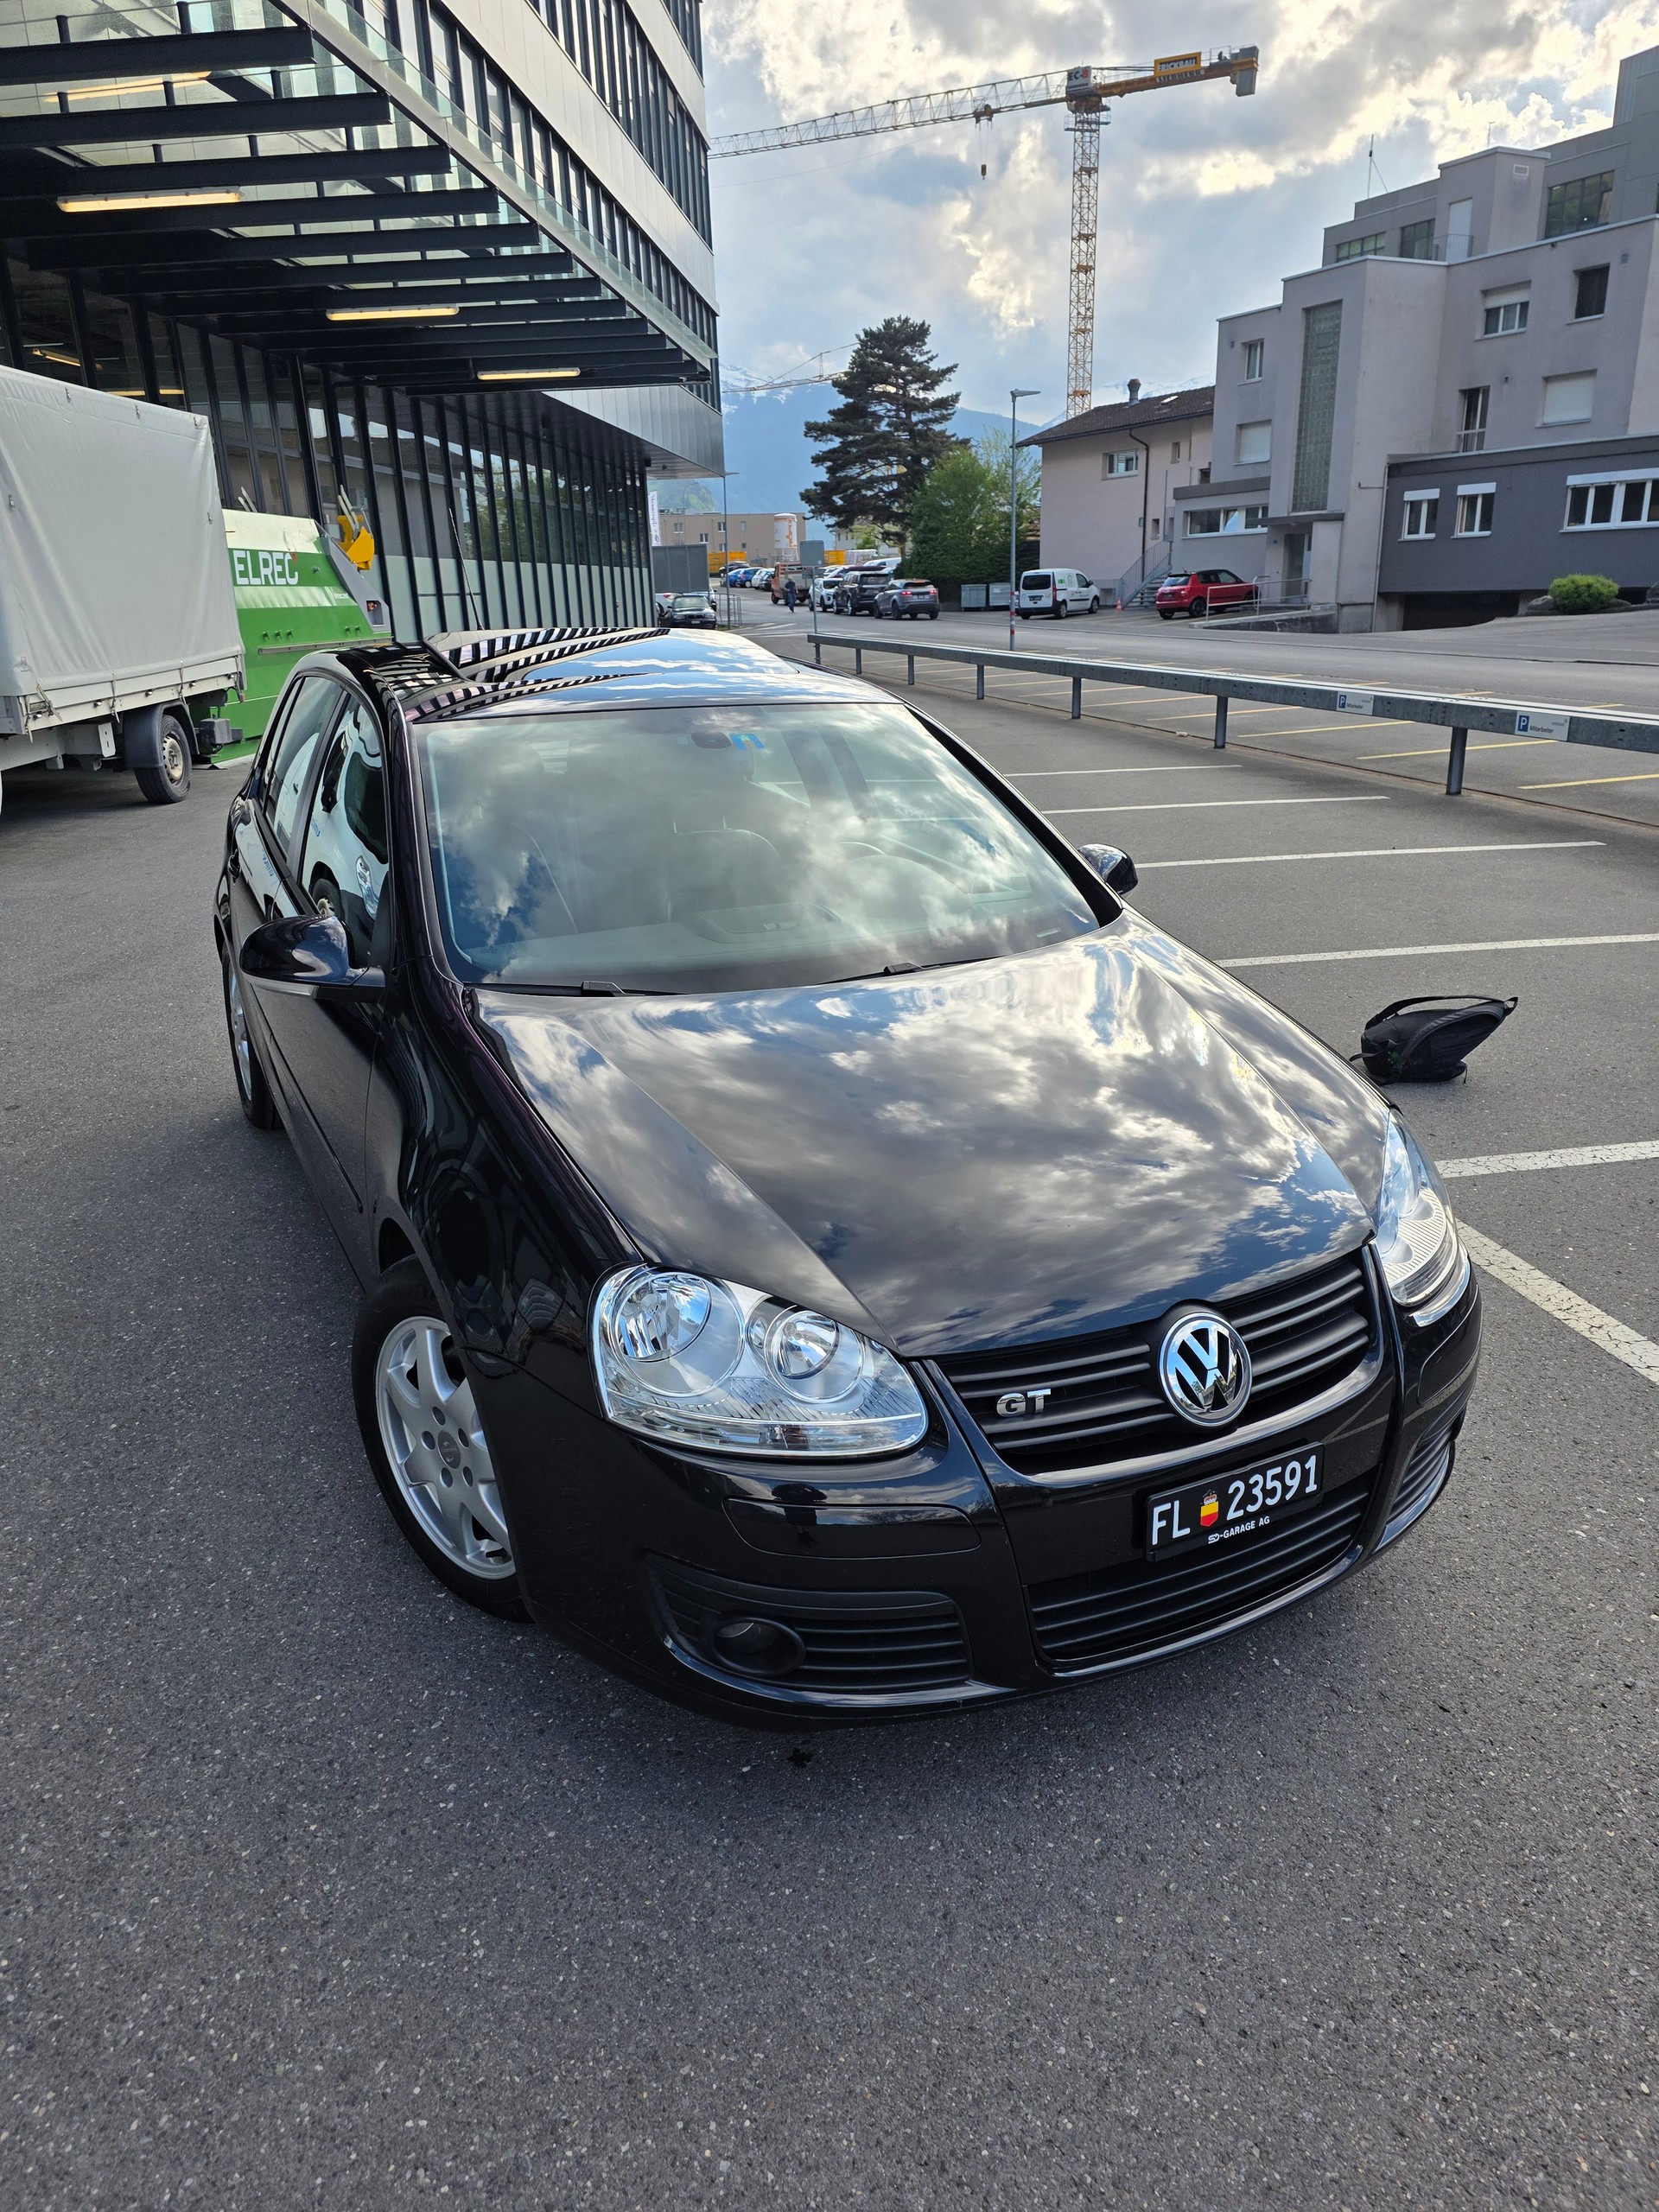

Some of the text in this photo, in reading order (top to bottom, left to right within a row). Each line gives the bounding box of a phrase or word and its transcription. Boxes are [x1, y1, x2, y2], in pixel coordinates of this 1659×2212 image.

[232, 550, 298, 585] ELREC
[1340, 696, 1345, 707] P
[1521, 717, 1528, 730] P
[1529, 725, 1554, 734] Mitarbeiter
[996, 1389, 1052, 1418] GT
[1152, 1454, 1318, 1546] FL 23591
[1258, 1516, 1270, 1527] AG
